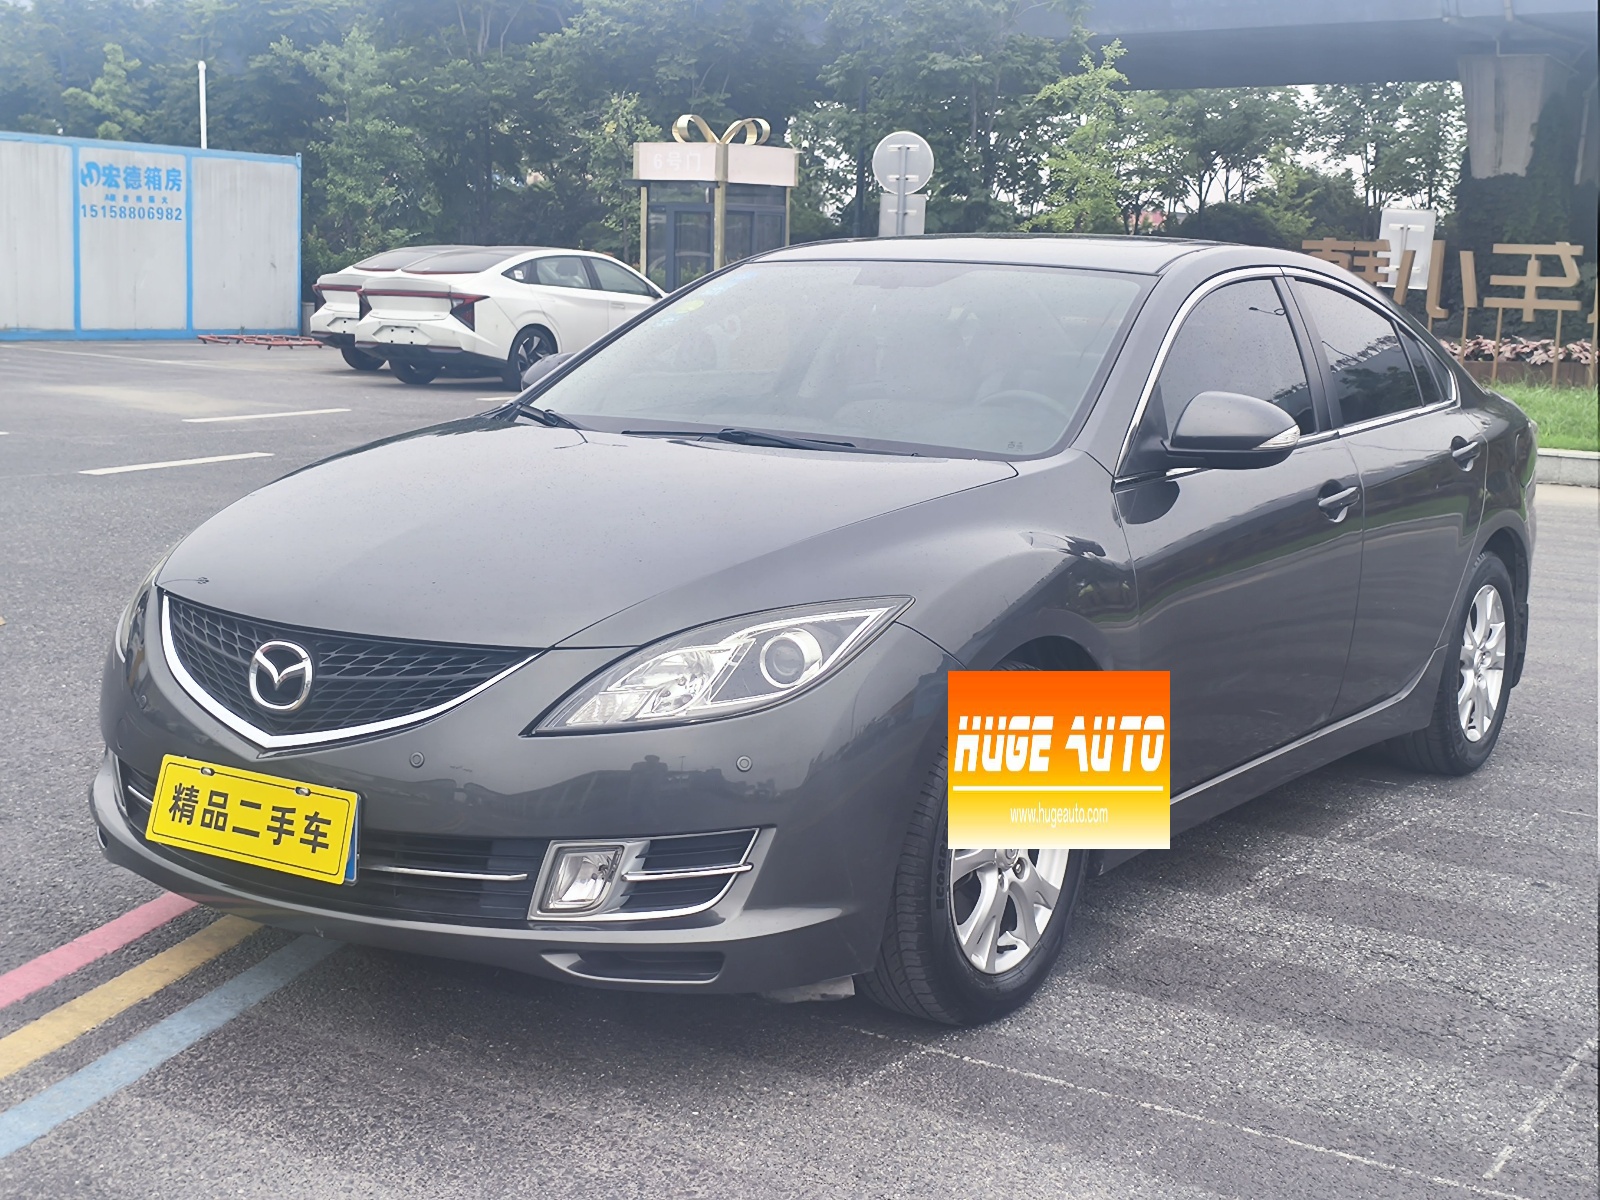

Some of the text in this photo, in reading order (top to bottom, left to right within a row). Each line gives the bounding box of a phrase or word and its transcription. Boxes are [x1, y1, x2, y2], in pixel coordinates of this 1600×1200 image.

[653, 151, 701, 173] 6号门
[102, 163, 182, 192] 宏德箱房
[81, 204, 182, 221] 15158806982
[168, 782, 332, 854] 精品二手车
